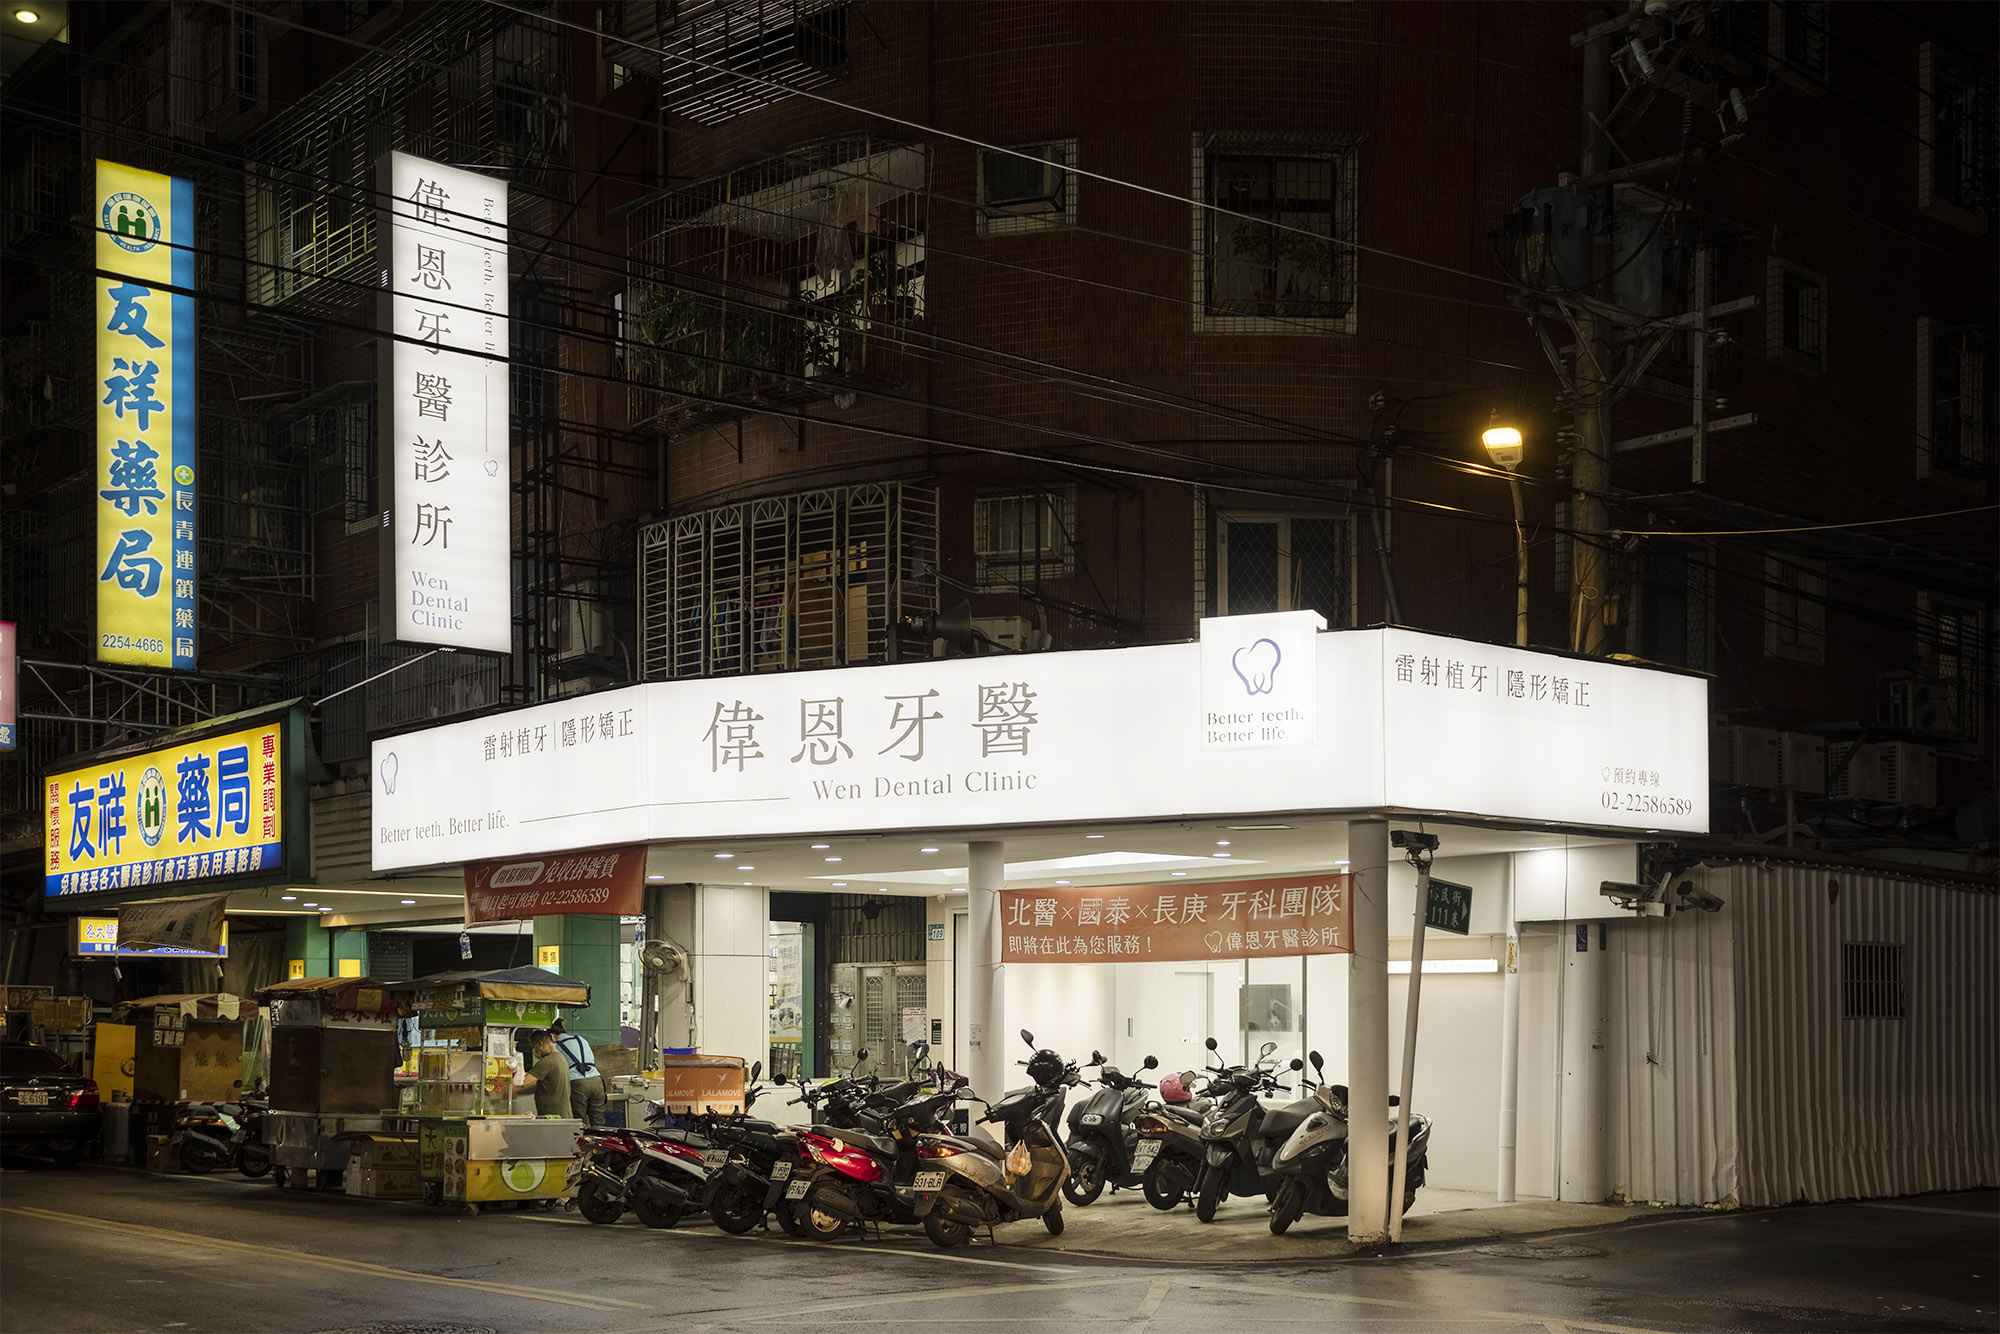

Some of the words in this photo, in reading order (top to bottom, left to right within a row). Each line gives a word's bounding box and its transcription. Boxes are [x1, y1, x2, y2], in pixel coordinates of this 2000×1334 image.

[485, 293, 495, 336] Beter
[410, 177, 455, 549] 偉恩牙醫診所
[485, 342, 496, 367] lie.
[99, 281, 167, 599] 友祥藥局
[175, 490, 194, 658] 長青連鎖藥局
[411, 570, 449, 590] Wen
[411, 590, 469, 612] Dental
[411, 609, 464, 630] Clinic
[102, 633, 164, 654] 2254-4666
[1395, 653, 1488, 693] 雷射植牙
[1507, 669, 1591, 707] 隱形矯正
[702, 681, 1039, 773] 偉恩牙醫
[1207, 712, 1254, 725] Better
[1261, 707, 1304, 722] teeth.
[483, 723, 547, 762] 雷射植牙
[561, 707, 634, 749] 隱形矯正
[1207, 730, 1254, 743] Better
[1261, 726, 1290, 740] life.
[262, 734, 276, 839] 專業調劑
[812, 779, 862, 800] Wen
[874, 774, 952, 798] Dental
[964, 770, 1038, 793] Clinic
[1613, 766, 1660, 788] 預約專線
[68, 771, 127, 863] 友祥
[176, 744, 250, 846] 藥局
[1601, 790, 1693, 816] 02-22586589
[380, 826, 411, 845] Better
[415, 819, 445, 840] teeth.
[449, 816, 483, 836] Better
[487, 810, 510, 831] life.
[540, 853, 620, 885] 免收掛號費
[480, 890, 540, 912] 即日起可預約
[540, 887, 610, 905] 02-22586589
[1217, 883, 1342, 922] 牙科團隊
[85, 923, 118, 941] 各大醫
[1225, 926, 1341, 951] 偉恩牙醫診所
[701, 1089, 742, 1097] LALAMOVE
